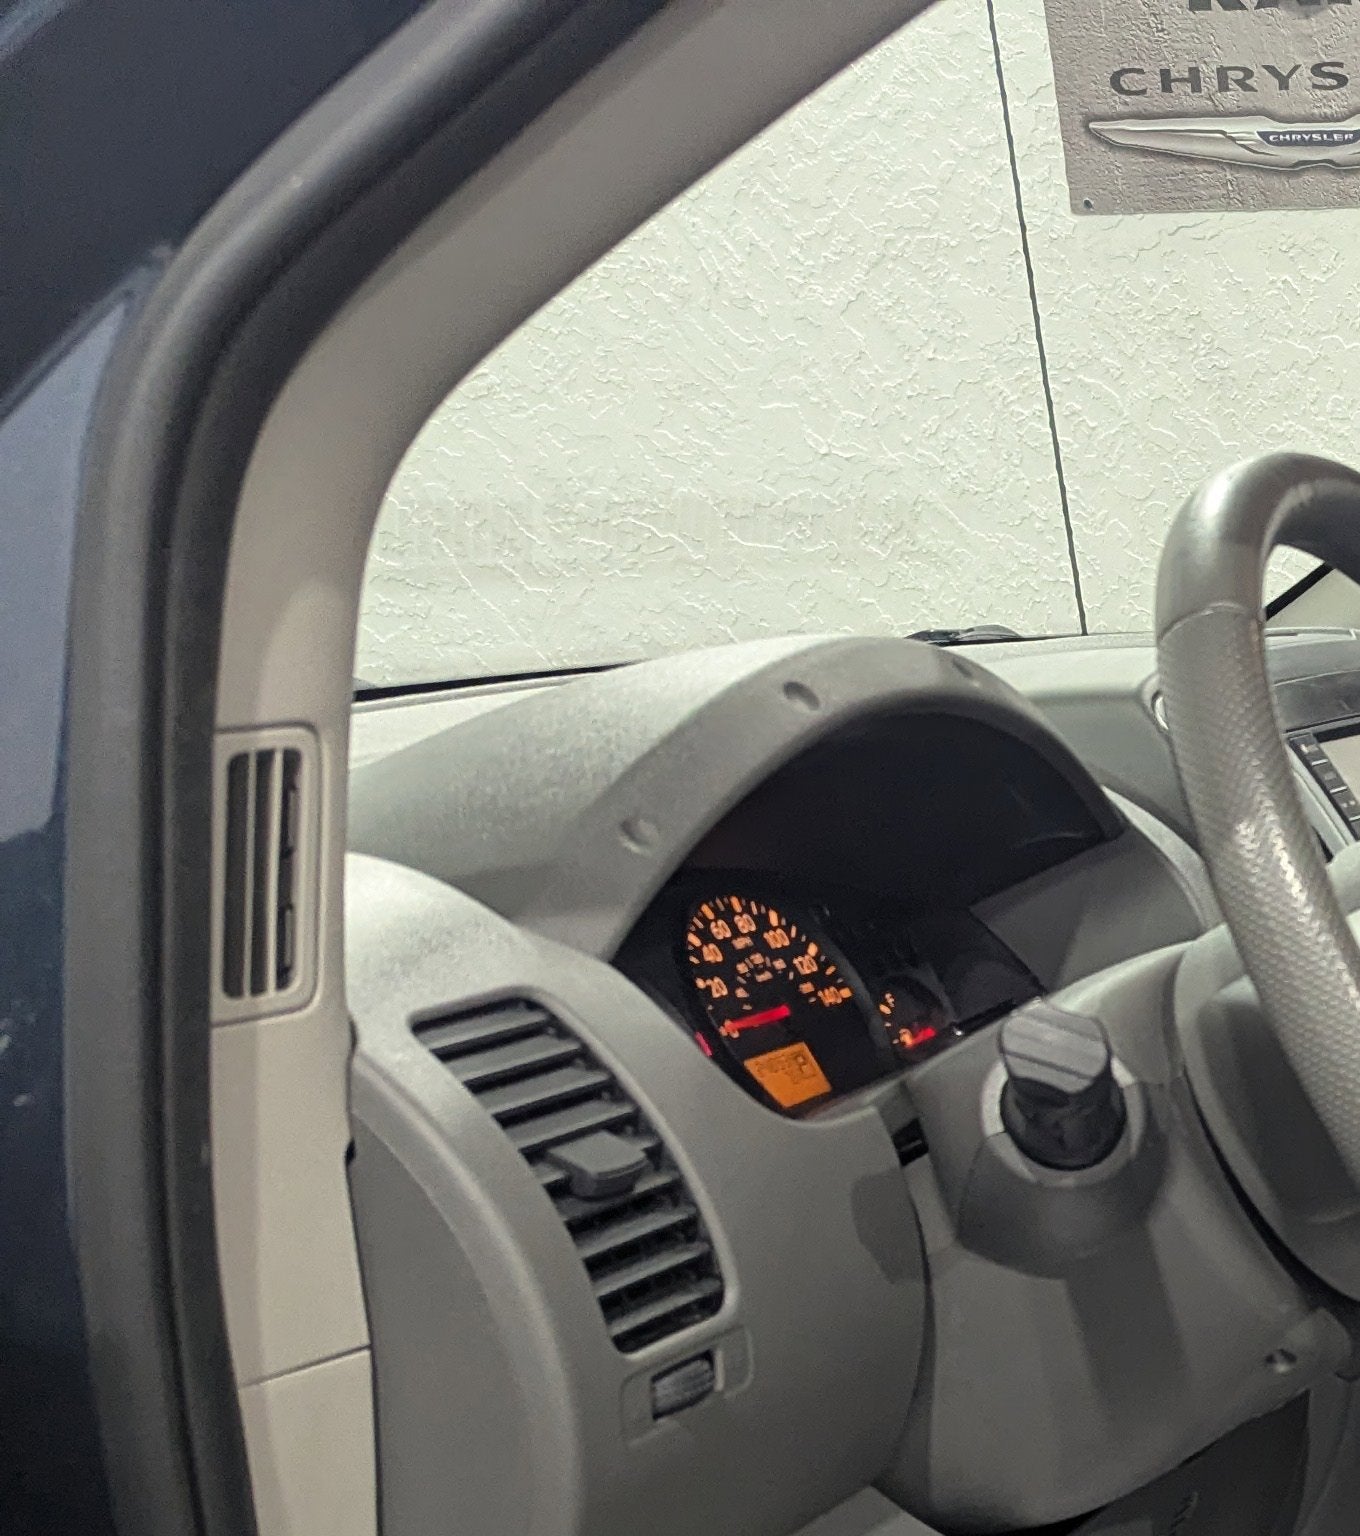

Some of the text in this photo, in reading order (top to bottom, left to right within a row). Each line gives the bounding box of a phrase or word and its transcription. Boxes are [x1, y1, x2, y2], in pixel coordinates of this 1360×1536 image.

[1268, 132, 1355, 142] CHRYSLER
[710, 918, 732, 940] 60
[733, 913, 757, 934] 80
[763, 927, 791, 950] 100
[702, 942, 724, 964] 40
[792, 954, 819, 976] 120
[705, 975, 729, 999] 20
[817, 985, 843, 1008] 140
